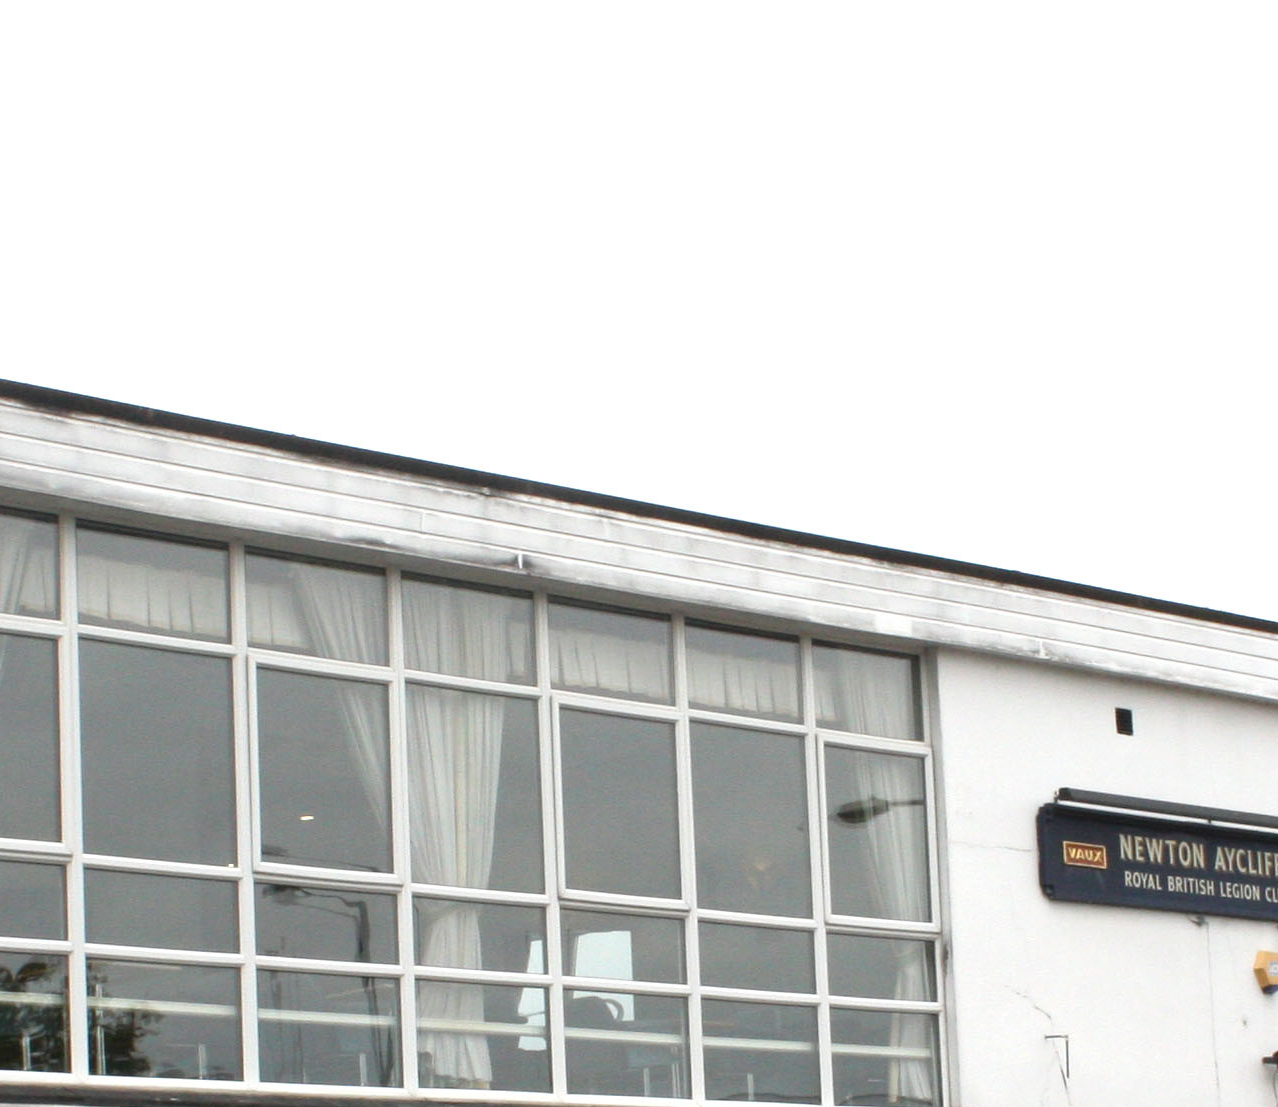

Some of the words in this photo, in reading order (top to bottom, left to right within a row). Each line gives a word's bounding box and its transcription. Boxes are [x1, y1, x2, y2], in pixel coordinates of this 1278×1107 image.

[1066, 846, 1103, 864] VAUX
[1119, 834, 1205, 869] NEWTON
[1124, 871, 1162, 891] ROYAL
[1167, 875, 1215, 896] BRITISH
[1219, 881, 1261, 901] LEGION
